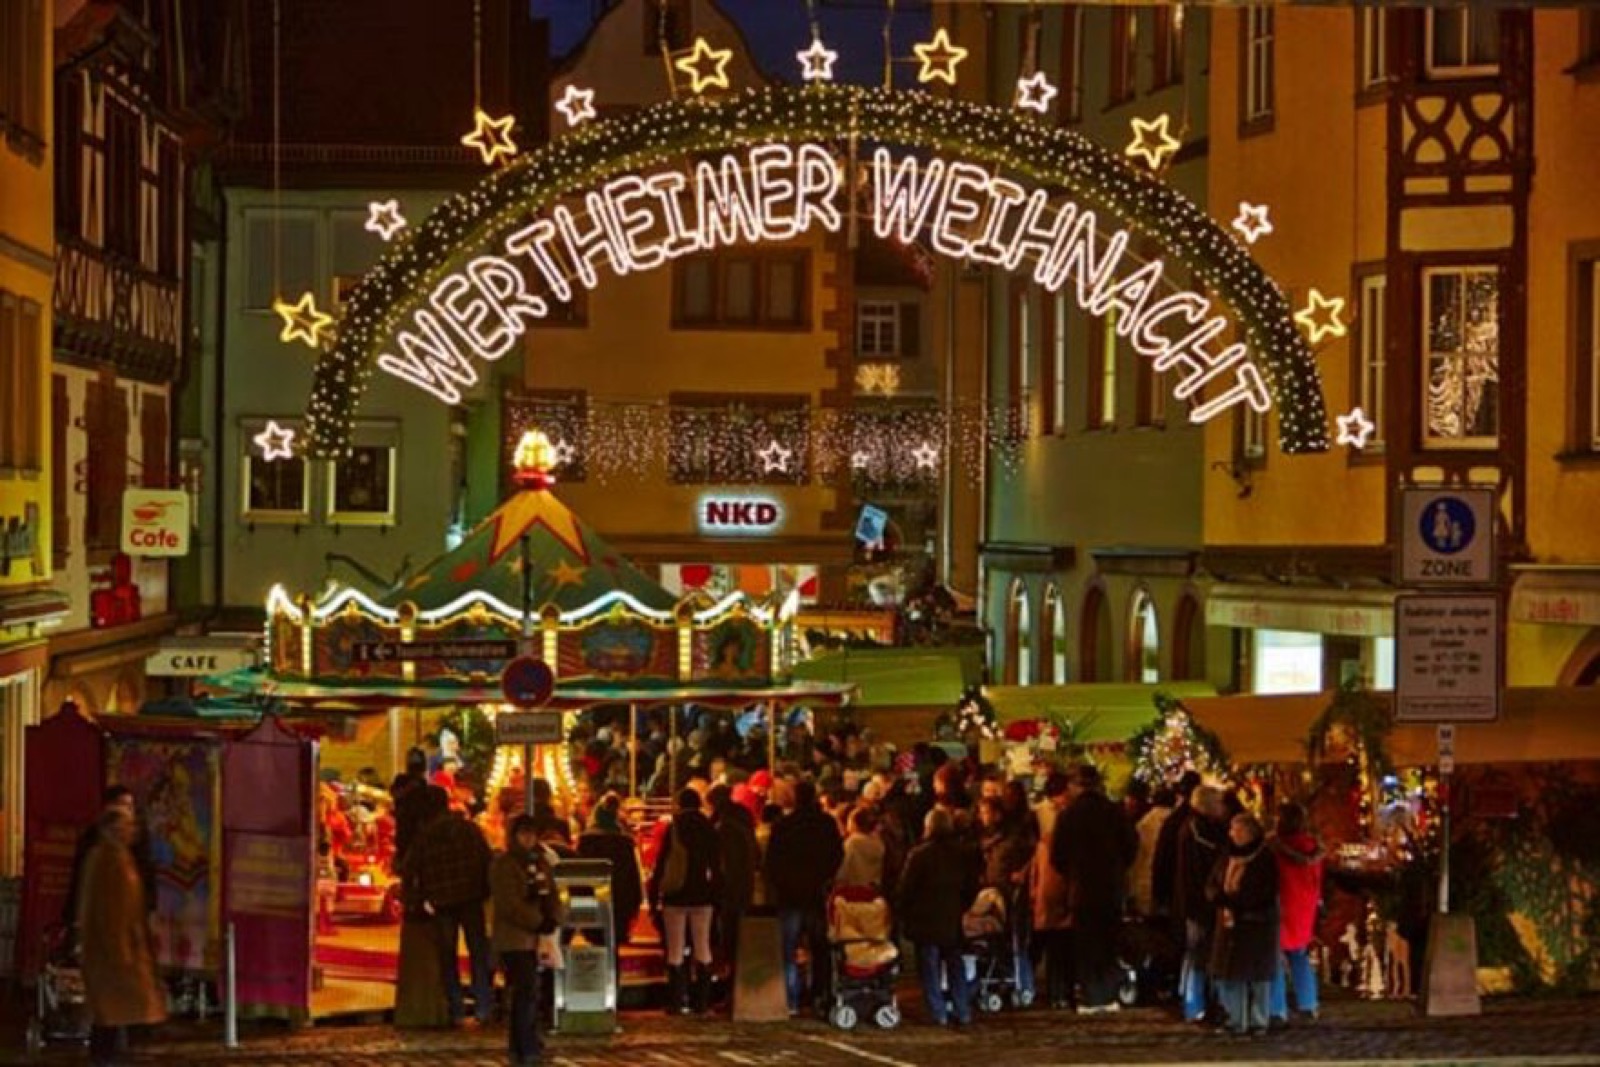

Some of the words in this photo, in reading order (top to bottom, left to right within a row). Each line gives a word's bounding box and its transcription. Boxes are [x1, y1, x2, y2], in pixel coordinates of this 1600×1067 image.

[377, 143, 842, 405] WERTHEIMER
[873, 147, 1272, 424] WEIHNACHT
[705, 501, 777, 526] NKD
[130, 528, 179, 548] Cafe
[1420, 559, 1473, 577] ZONE
[170, 655, 217, 670] CAFE
